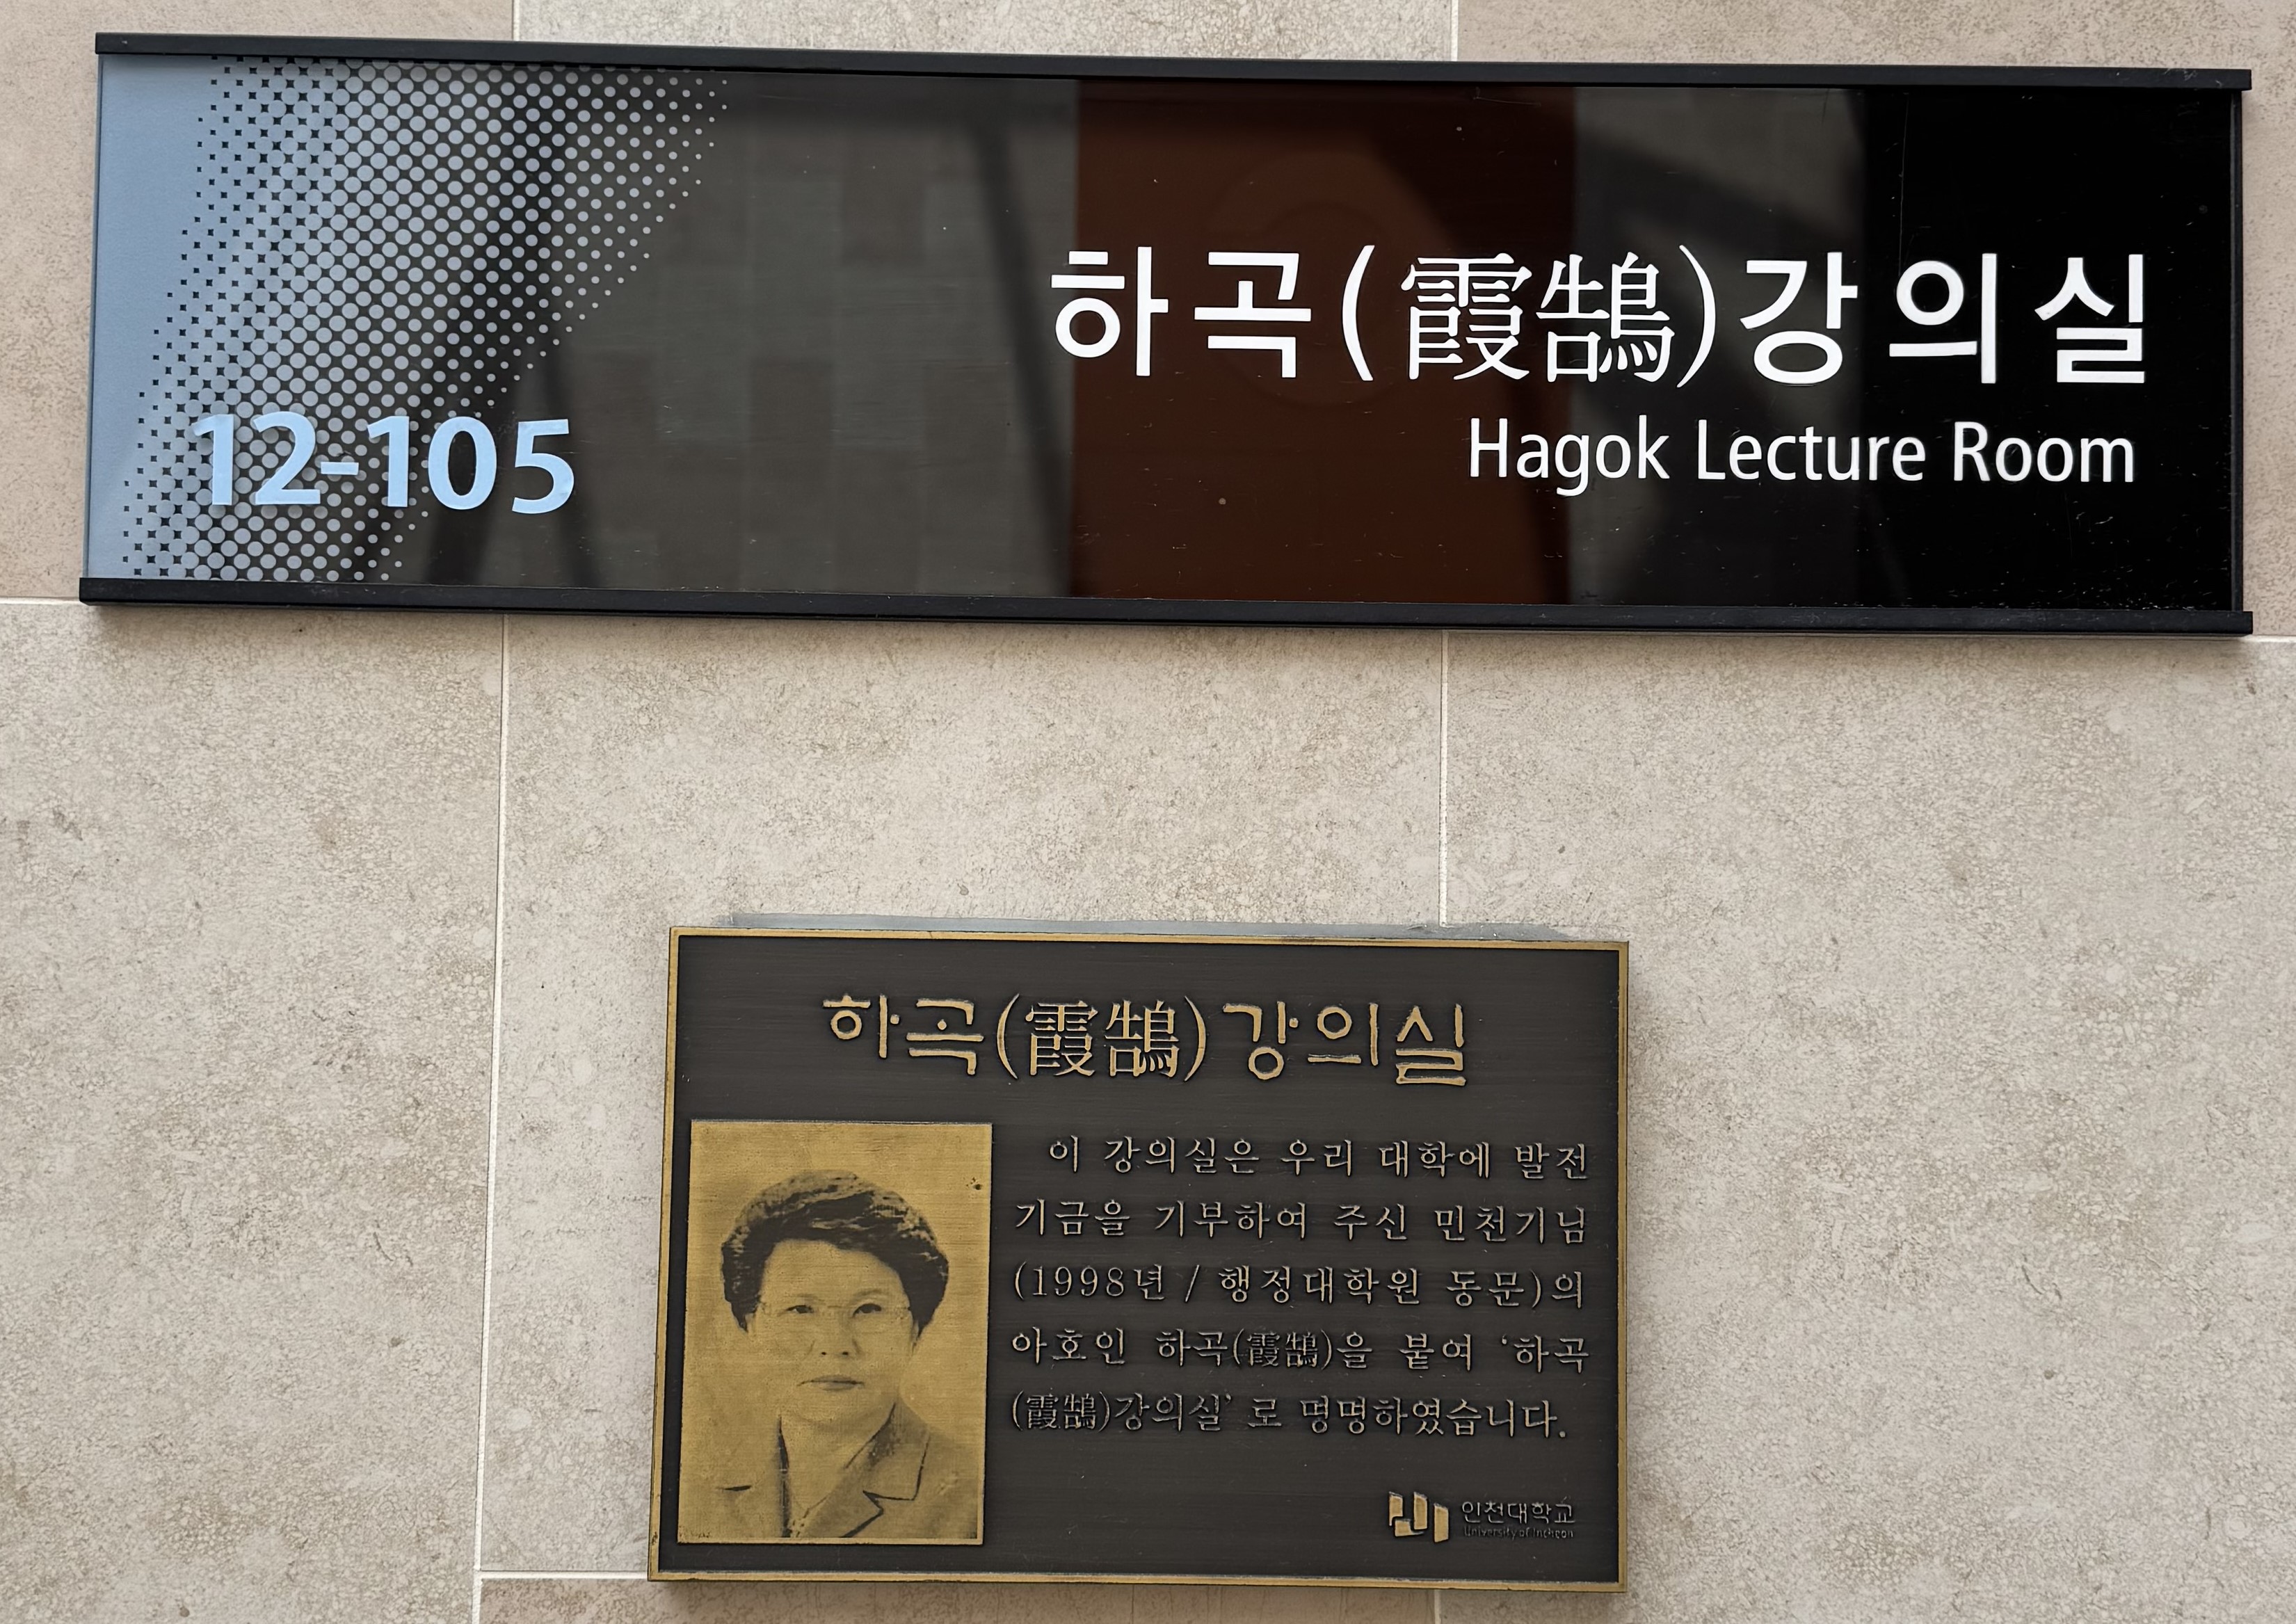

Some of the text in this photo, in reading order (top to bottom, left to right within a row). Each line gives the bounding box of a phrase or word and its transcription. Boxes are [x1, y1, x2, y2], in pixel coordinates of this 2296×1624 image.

[192, 410, 575, 515] 12-105
[1469, 415, 2135, 495] Hagok Lecture Room
[1050, 1135, 1589, 1180] 이 강의실은 우리 대학에 발전
[1015, 1199, 1586, 1244] 기금을 기부하여 주신 민천기님
[1014, 1262, 1582, 1309] (1998년 / 행정대학원 동문)의
[1012, 1326, 1125, 1365] 아호인
[1399, 1333, 1471, 1372] 붙여
[1248, 1397, 1282, 1429] 로
[1301, 1395, 1566, 1438] 명명하였습니다.
[1461, 1500, 1575, 1524] 인천대학교
[1463, 1525, 1516, 1541] University
[1519, 1527, 1530, 1538] of
